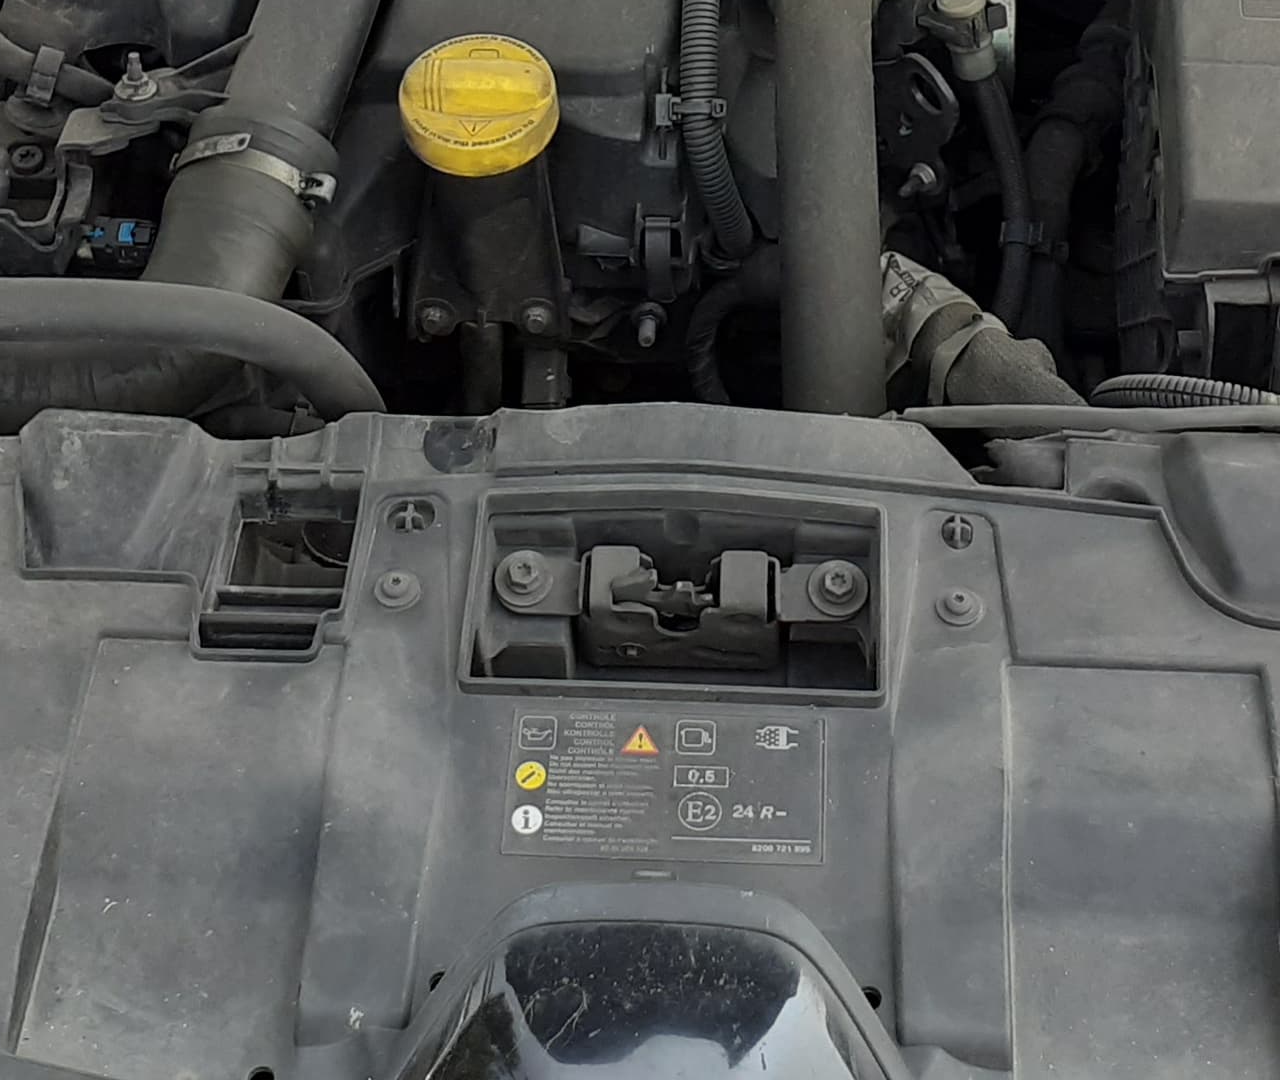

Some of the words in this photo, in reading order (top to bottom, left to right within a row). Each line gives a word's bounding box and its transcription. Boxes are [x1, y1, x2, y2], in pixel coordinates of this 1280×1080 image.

[564, 729, 615, 737] KONTROLLE
[686, 800, 717, 822] E2
[732, 804, 754, 818] 24
